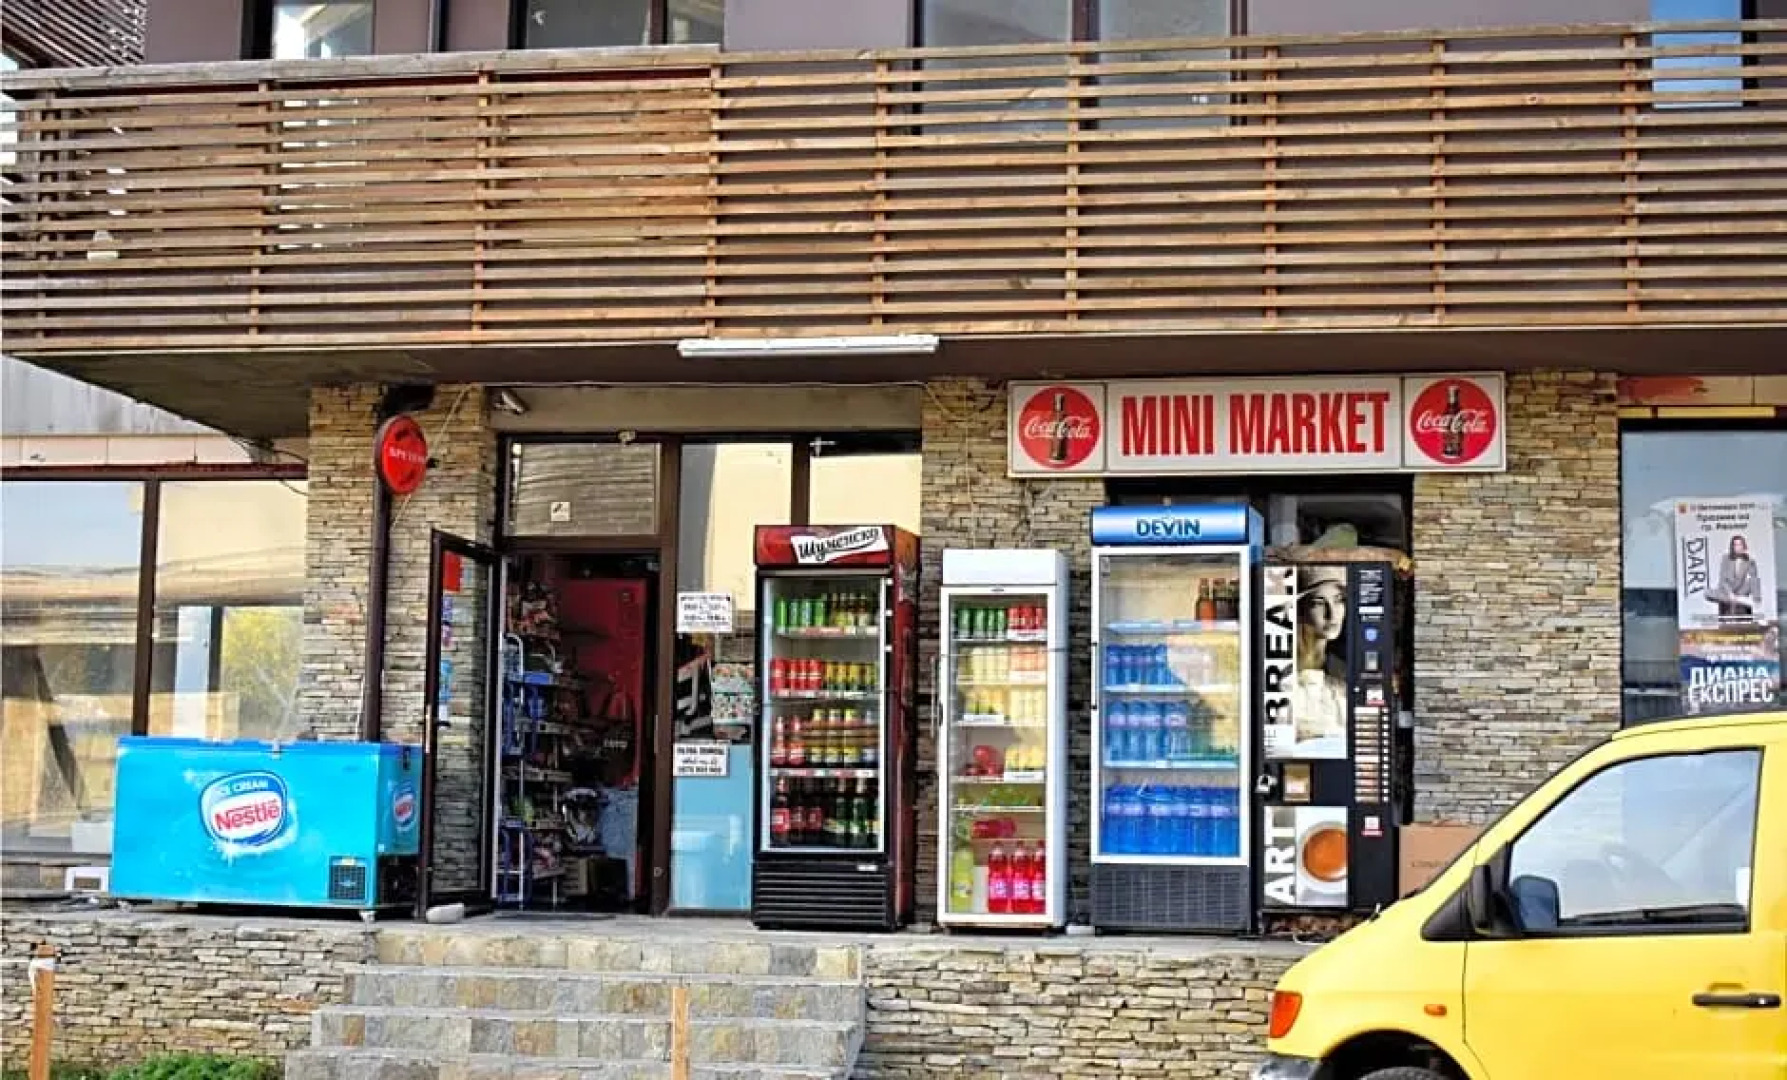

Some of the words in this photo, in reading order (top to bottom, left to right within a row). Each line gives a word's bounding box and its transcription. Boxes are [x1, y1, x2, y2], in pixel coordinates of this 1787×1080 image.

[1122, 394, 1214, 456] MINI
[1229, 392, 1390, 455] MARKET
[1136, 517, 1201, 537] DEVIN
[1690, 666, 1769, 689] ДИАНА
[1688, 678, 1774, 704] ЕКСПРЕС
[1264, 806, 1296, 905] ART
